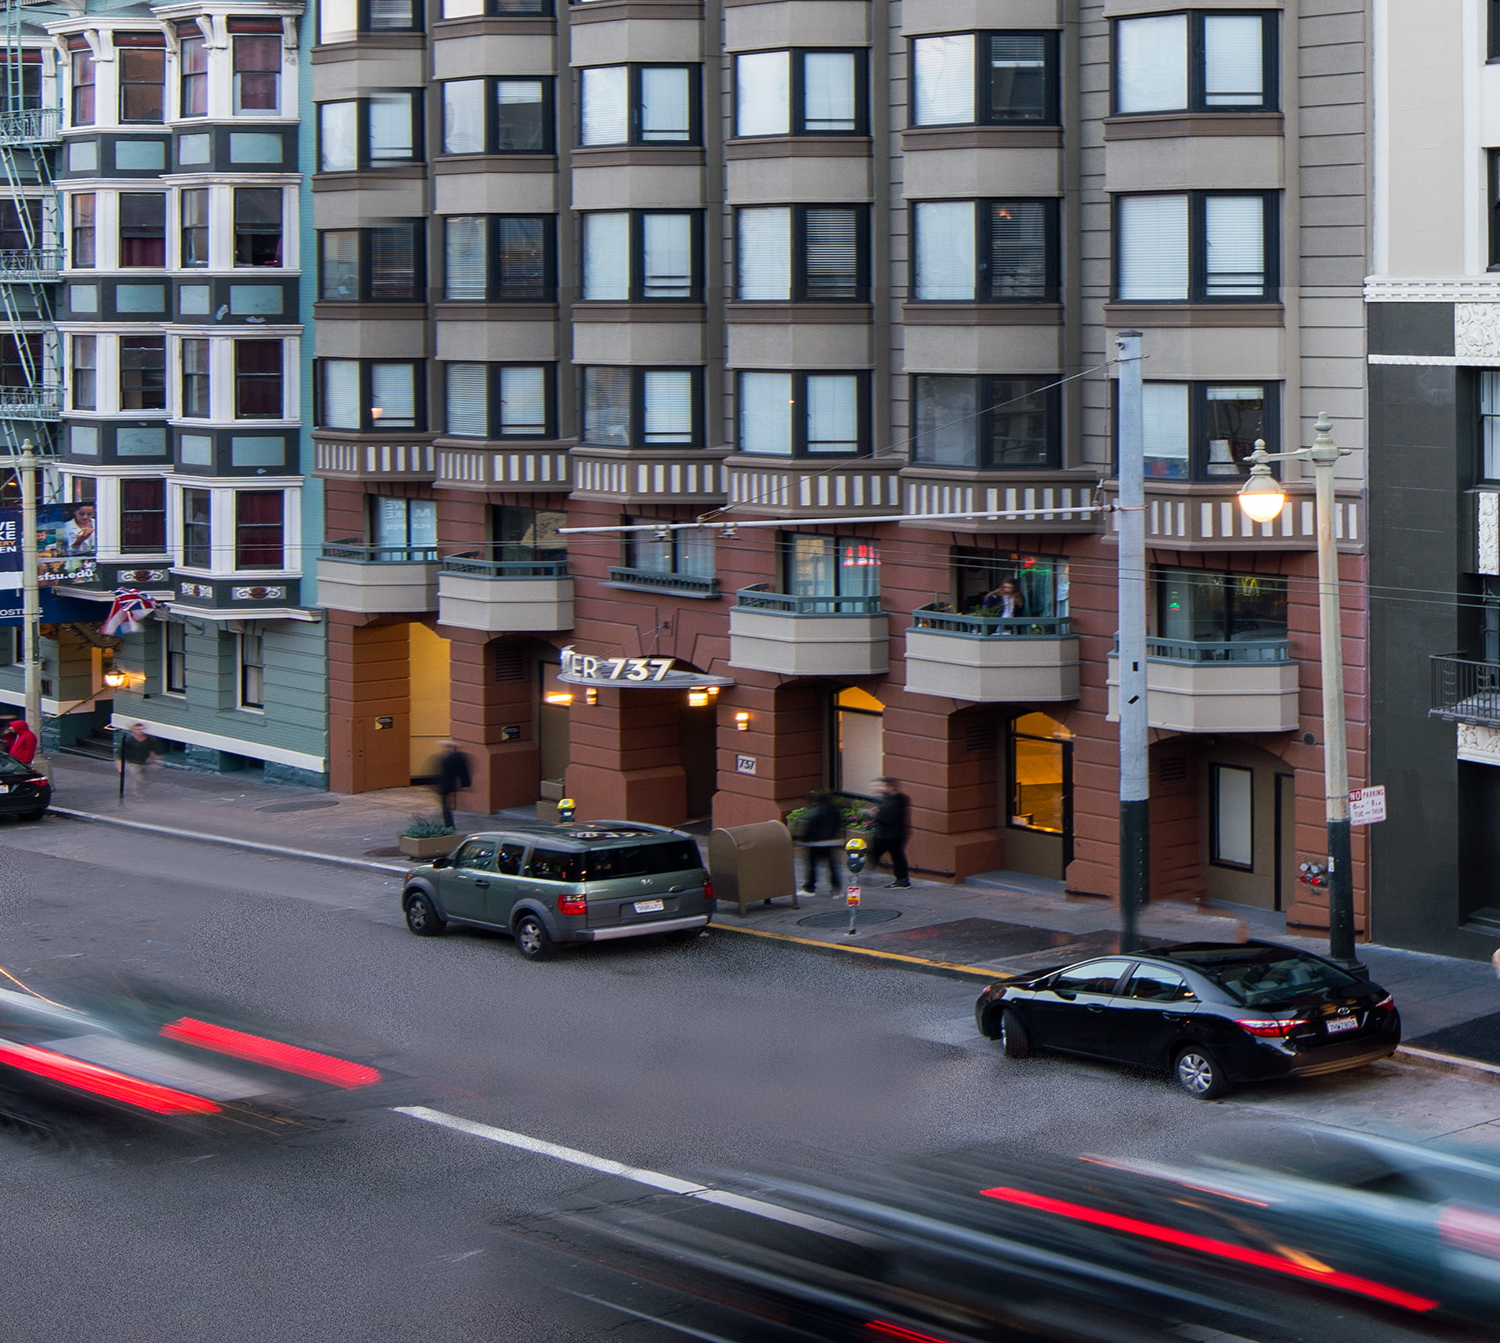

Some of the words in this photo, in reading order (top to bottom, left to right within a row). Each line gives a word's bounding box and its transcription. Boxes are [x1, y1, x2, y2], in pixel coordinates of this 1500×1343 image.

[37, 567, 93, 582] sfsu.edu
[608, 658, 676, 681] 737
[739, 758, 755, 770] 737
[1363, 789, 1384, 798] PARKING
